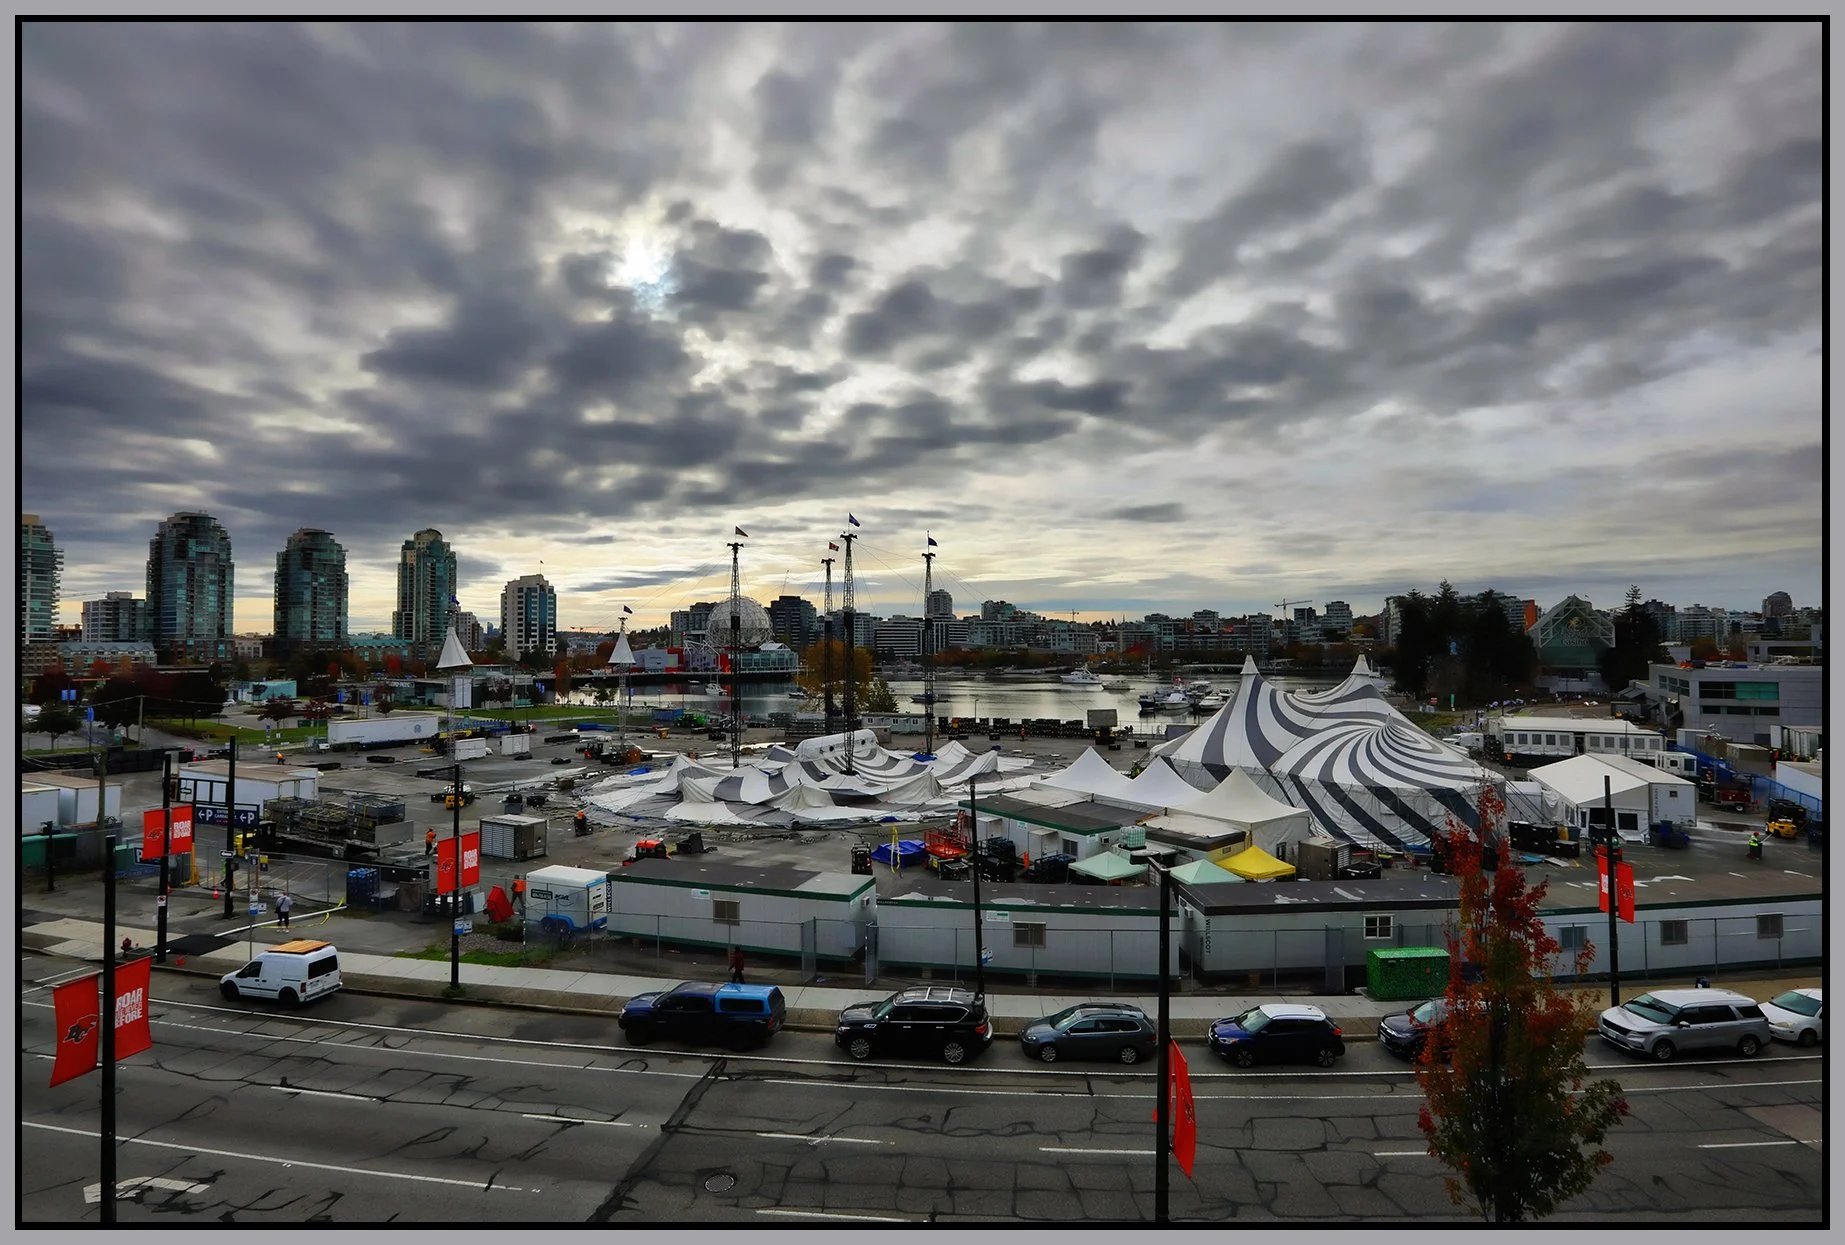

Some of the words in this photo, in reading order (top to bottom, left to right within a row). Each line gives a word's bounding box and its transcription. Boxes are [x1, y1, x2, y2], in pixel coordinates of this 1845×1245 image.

[205, 808, 214, 822] P
[247, 811, 256, 825] P
[115, 987, 143, 1012] ROAR
